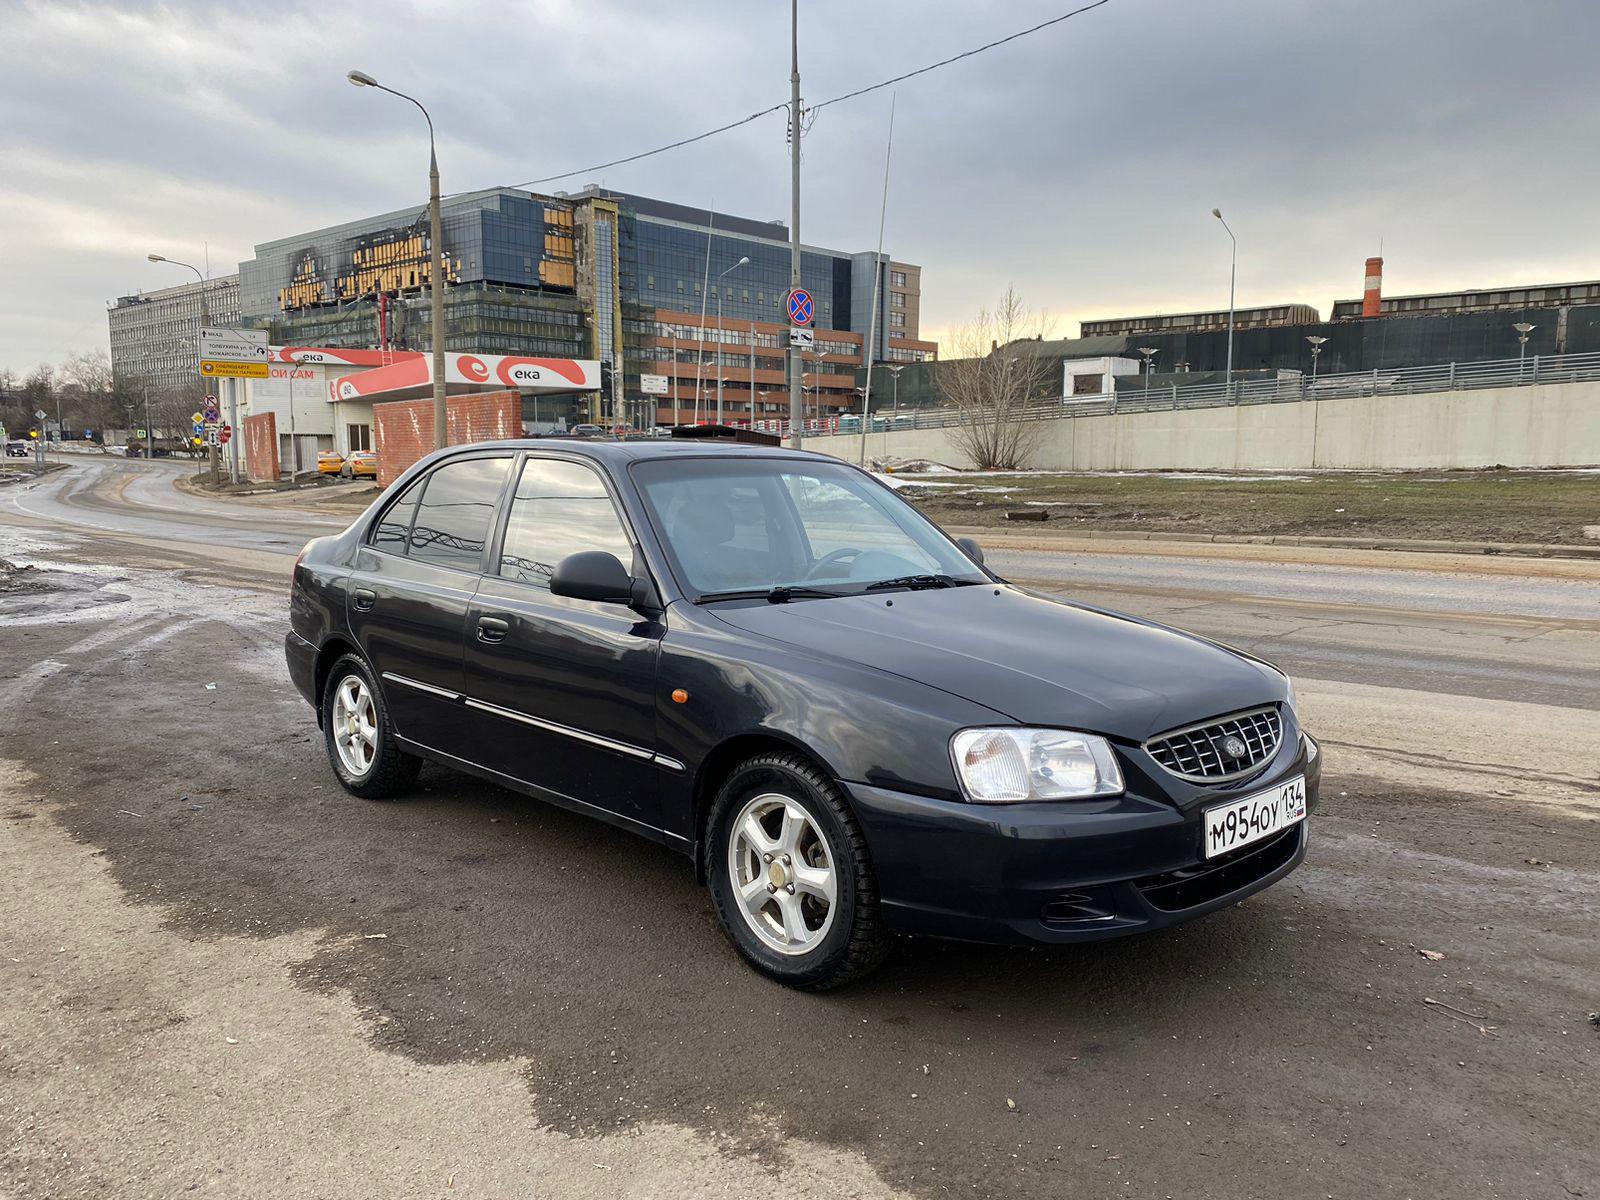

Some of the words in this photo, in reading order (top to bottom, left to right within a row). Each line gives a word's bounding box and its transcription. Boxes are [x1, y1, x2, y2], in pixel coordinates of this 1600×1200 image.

[271, 368, 288, 378] ОЙ
[1281, 782, 1304, 812] 134
[1286, 809, 1297, 821] RUS
